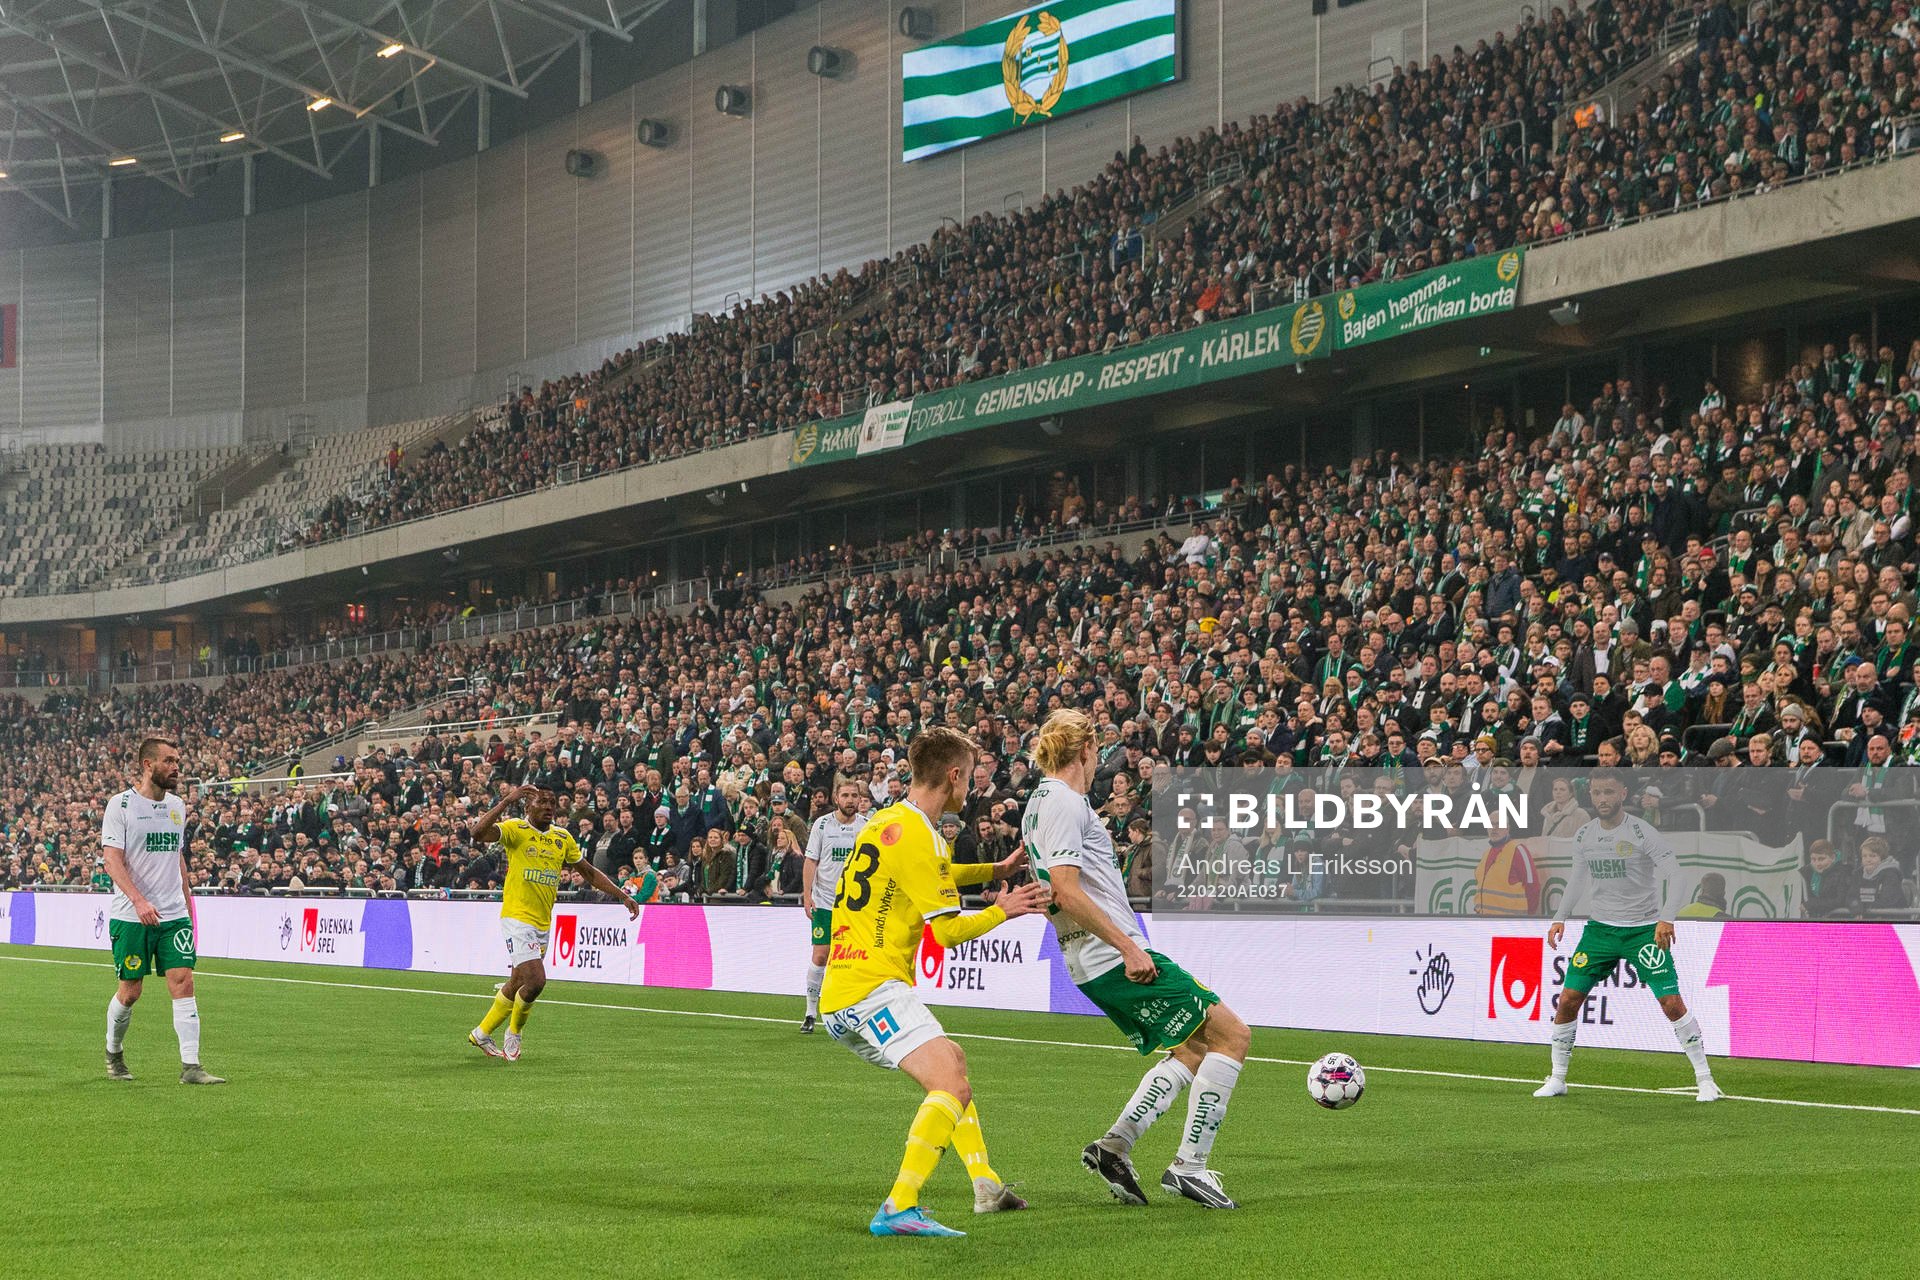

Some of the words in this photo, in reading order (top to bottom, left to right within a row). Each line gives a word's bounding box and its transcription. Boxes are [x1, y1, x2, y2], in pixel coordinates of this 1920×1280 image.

[1343, 310, 1386, 344] Bajen
[1388, 274, 1461, 317] hemma...
[1401, 301, 1466, 330] ...Kinkan
[1469, 287, 1514, 314] borta
[909, 398, 965, 433] FOTBOLL
[974, 371, 1084, 416] GEMENSKAP
[1097, 347, 1185, 391] RESPEKT
[1200, 323, 1281, 368] KÄRLEK
[1632, 823, 1645, 840] BST
[1588, 860, 1627, 873] HUSKI
[877, 878, 897, 917] Nyheter
[319, 918, 354, 935] SVENSKA
[579, 926, 628, 947] SVENSKA
[317, 937, 336, 954] SPEL
[950, 939, 1023, 964] SVENSKA
[577, 949, 603, 969] SPEL
[948, 966, 985, 991] SPEL
[1128, 1075, 1173, 1123] Clinton
[1188, 1091, 1220, 1144] Clinton
